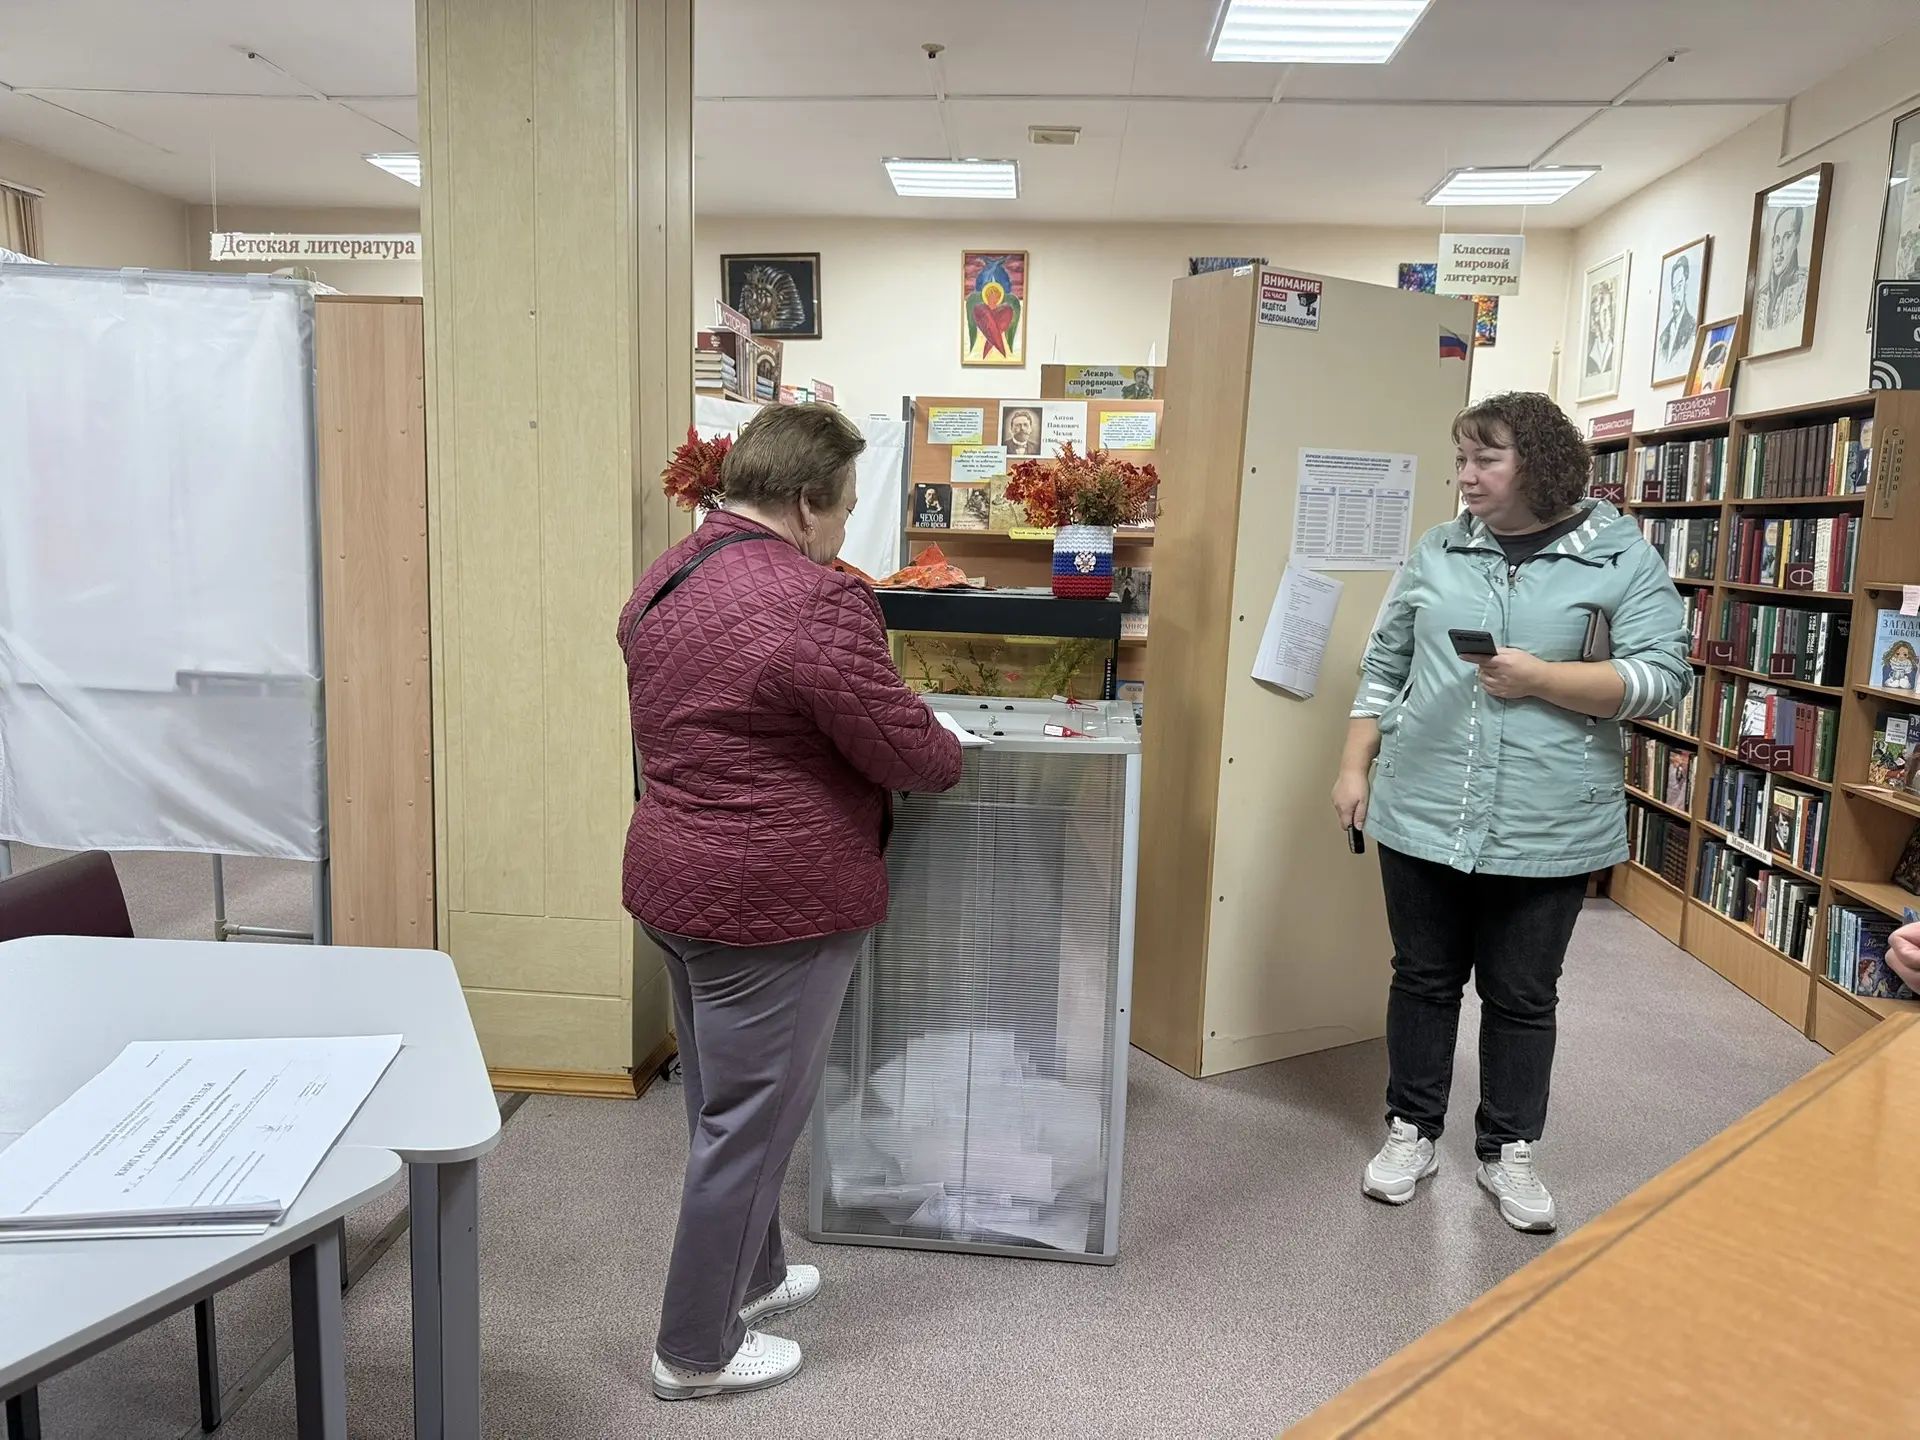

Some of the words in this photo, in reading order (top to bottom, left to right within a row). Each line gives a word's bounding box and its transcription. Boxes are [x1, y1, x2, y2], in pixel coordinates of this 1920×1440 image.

[220, 235, 300, 256] Детская
[304, 239, 416, 259] литература
[1453, 243, 1511, 256] Классика
[1455, 259, 1510, 271] мировой
[1263, 274, 1321, 293] ВНИМАНИЕ
[1444, 274, 1517, 286] литературы
[1272, 292, 1286, 300] ЧАСА
[1261, 301, 1287, 312] ВЕДЁТСЯ
[1260, 312, 1317, 327] ВИДЕОНАБЛЮДЕНИЕ
[1672, 396, 1717, 412] РОССИЙСКАЯ
[1645, 484, 1661, 499] Н
[920, 514, 944, 522] ЧЕХОВ
[1789, 568, 1814, 586] Ф
[1715, 645, 1733, 662] Ч
[1770, 658, 1796, 675] Ш
[1774, 749, 1791, 767] Я
[113, 1153, 146, 1176] КНИГА
[139, 1124, 174, 1154] СПИСКА
[166, 1081, 217, 1124] ИЗБИРАТЕЛЕЙ
